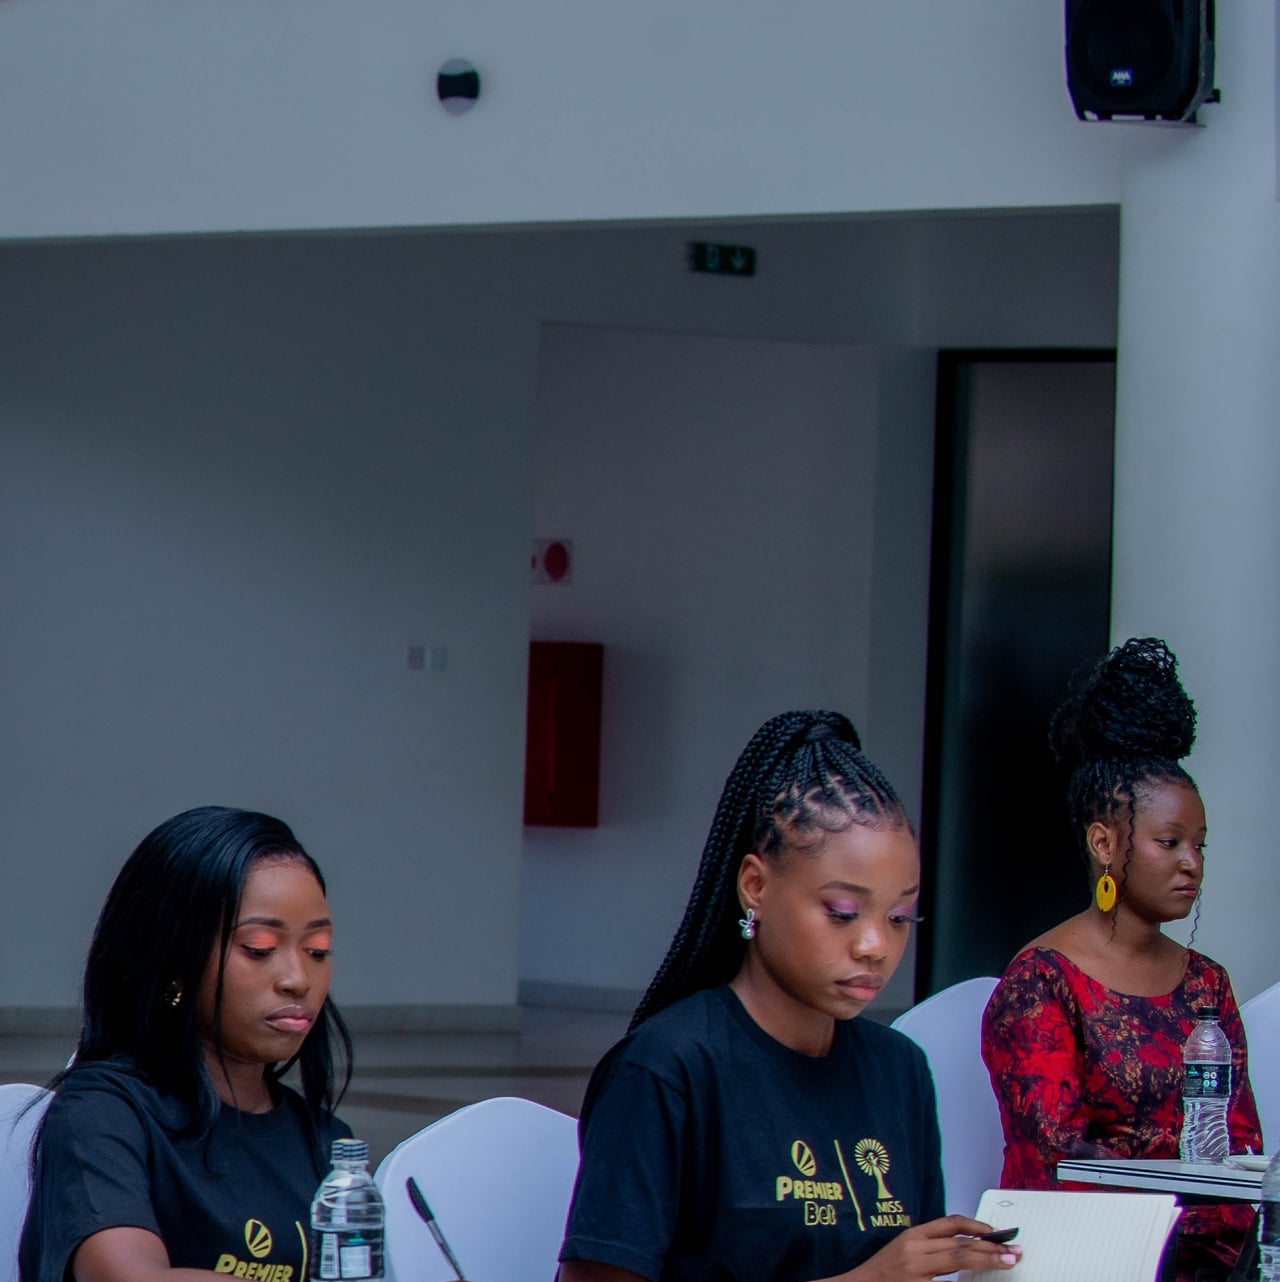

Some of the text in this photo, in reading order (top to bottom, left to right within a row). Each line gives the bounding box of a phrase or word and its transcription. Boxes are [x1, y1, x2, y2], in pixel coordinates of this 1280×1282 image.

[775, 1176, 844, 1201] PREMIER
[804, 1201, 837, 1226] Bet
[875, 1200, 904, 1213] MISS
